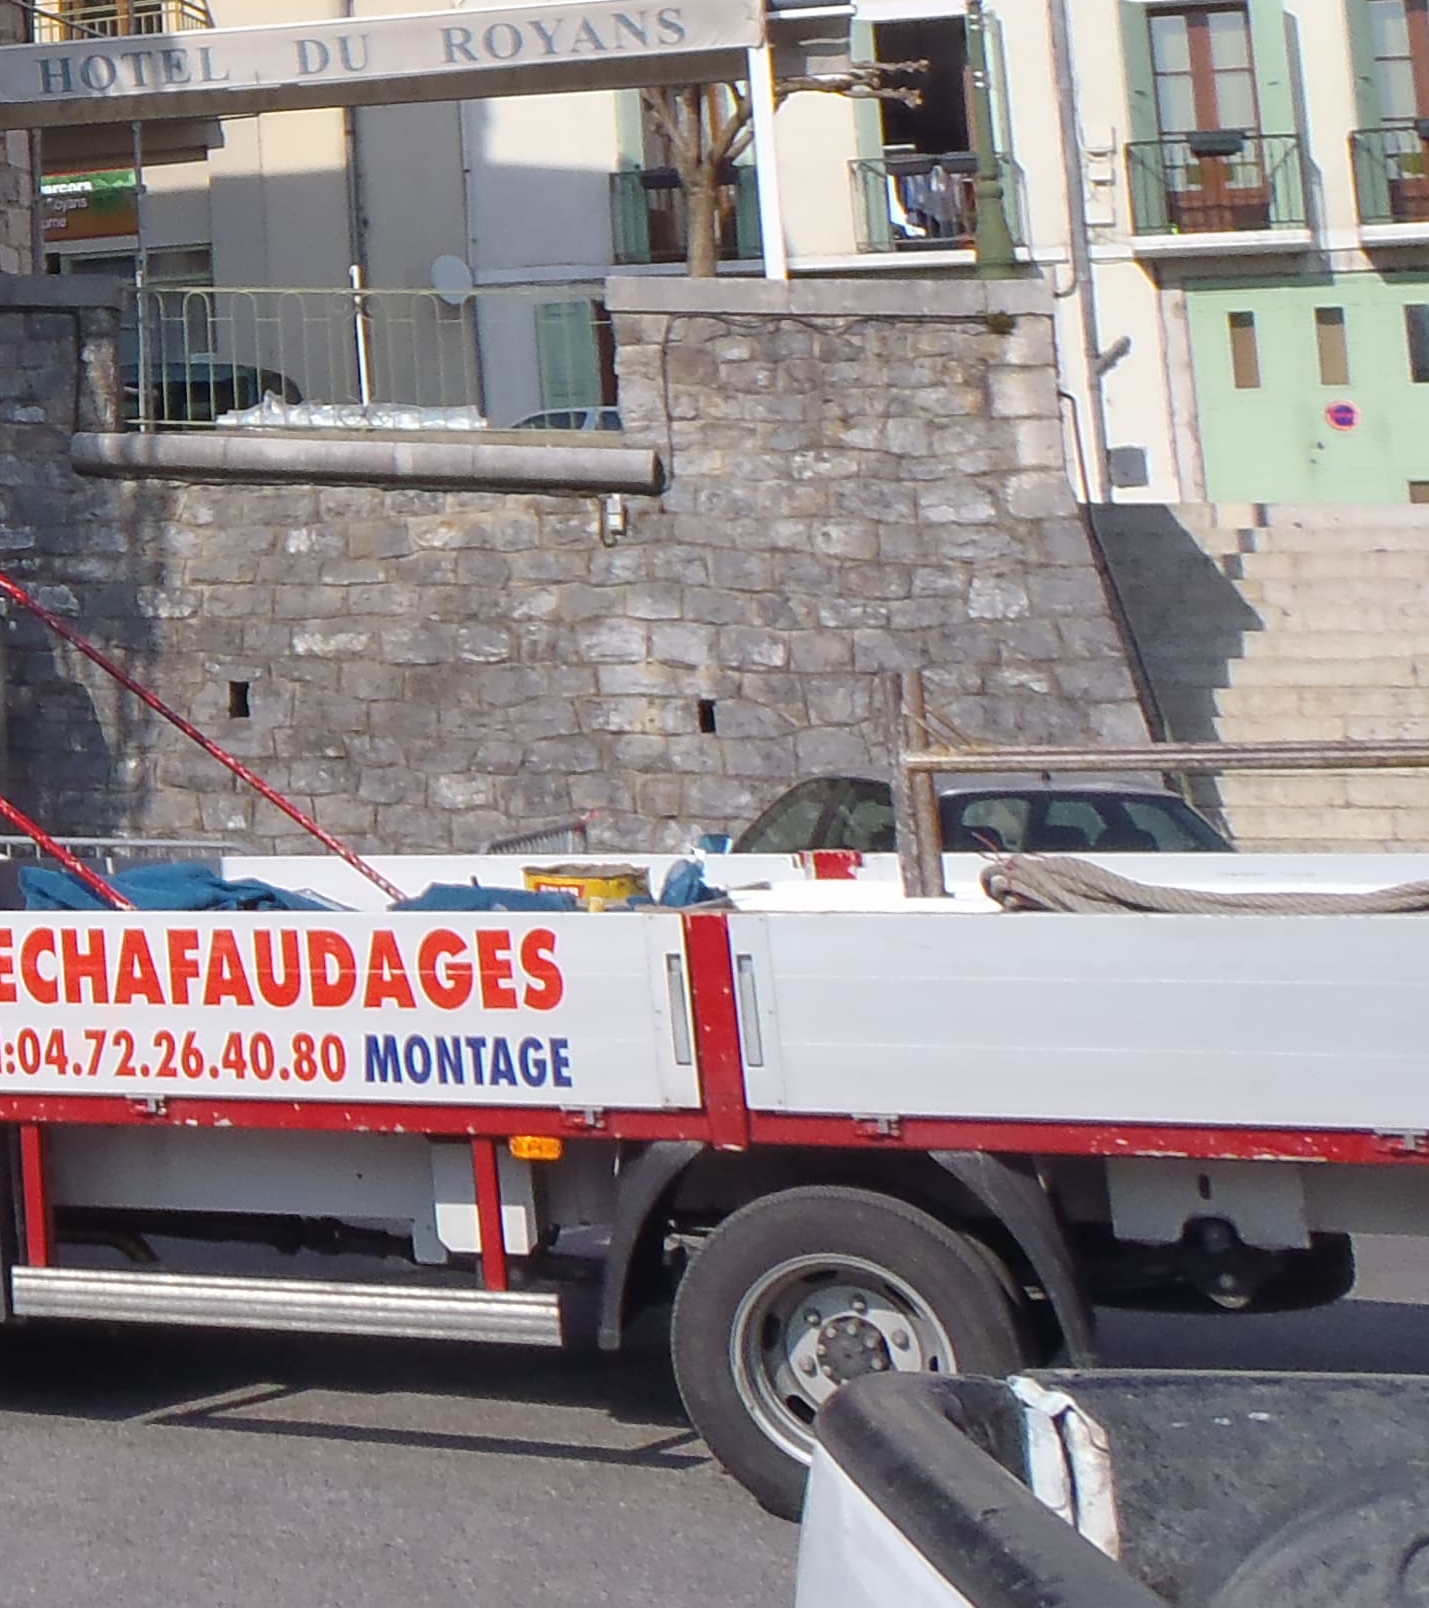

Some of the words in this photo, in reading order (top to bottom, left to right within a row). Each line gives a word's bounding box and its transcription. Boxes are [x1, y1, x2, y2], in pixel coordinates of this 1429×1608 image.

[36, 45, 230, 93] HOTEL
[294, 33, 371, 75] DU
[439, 7, 687, 64] ROYANS
[364, 1033, 574, 1089] MONTAGE
